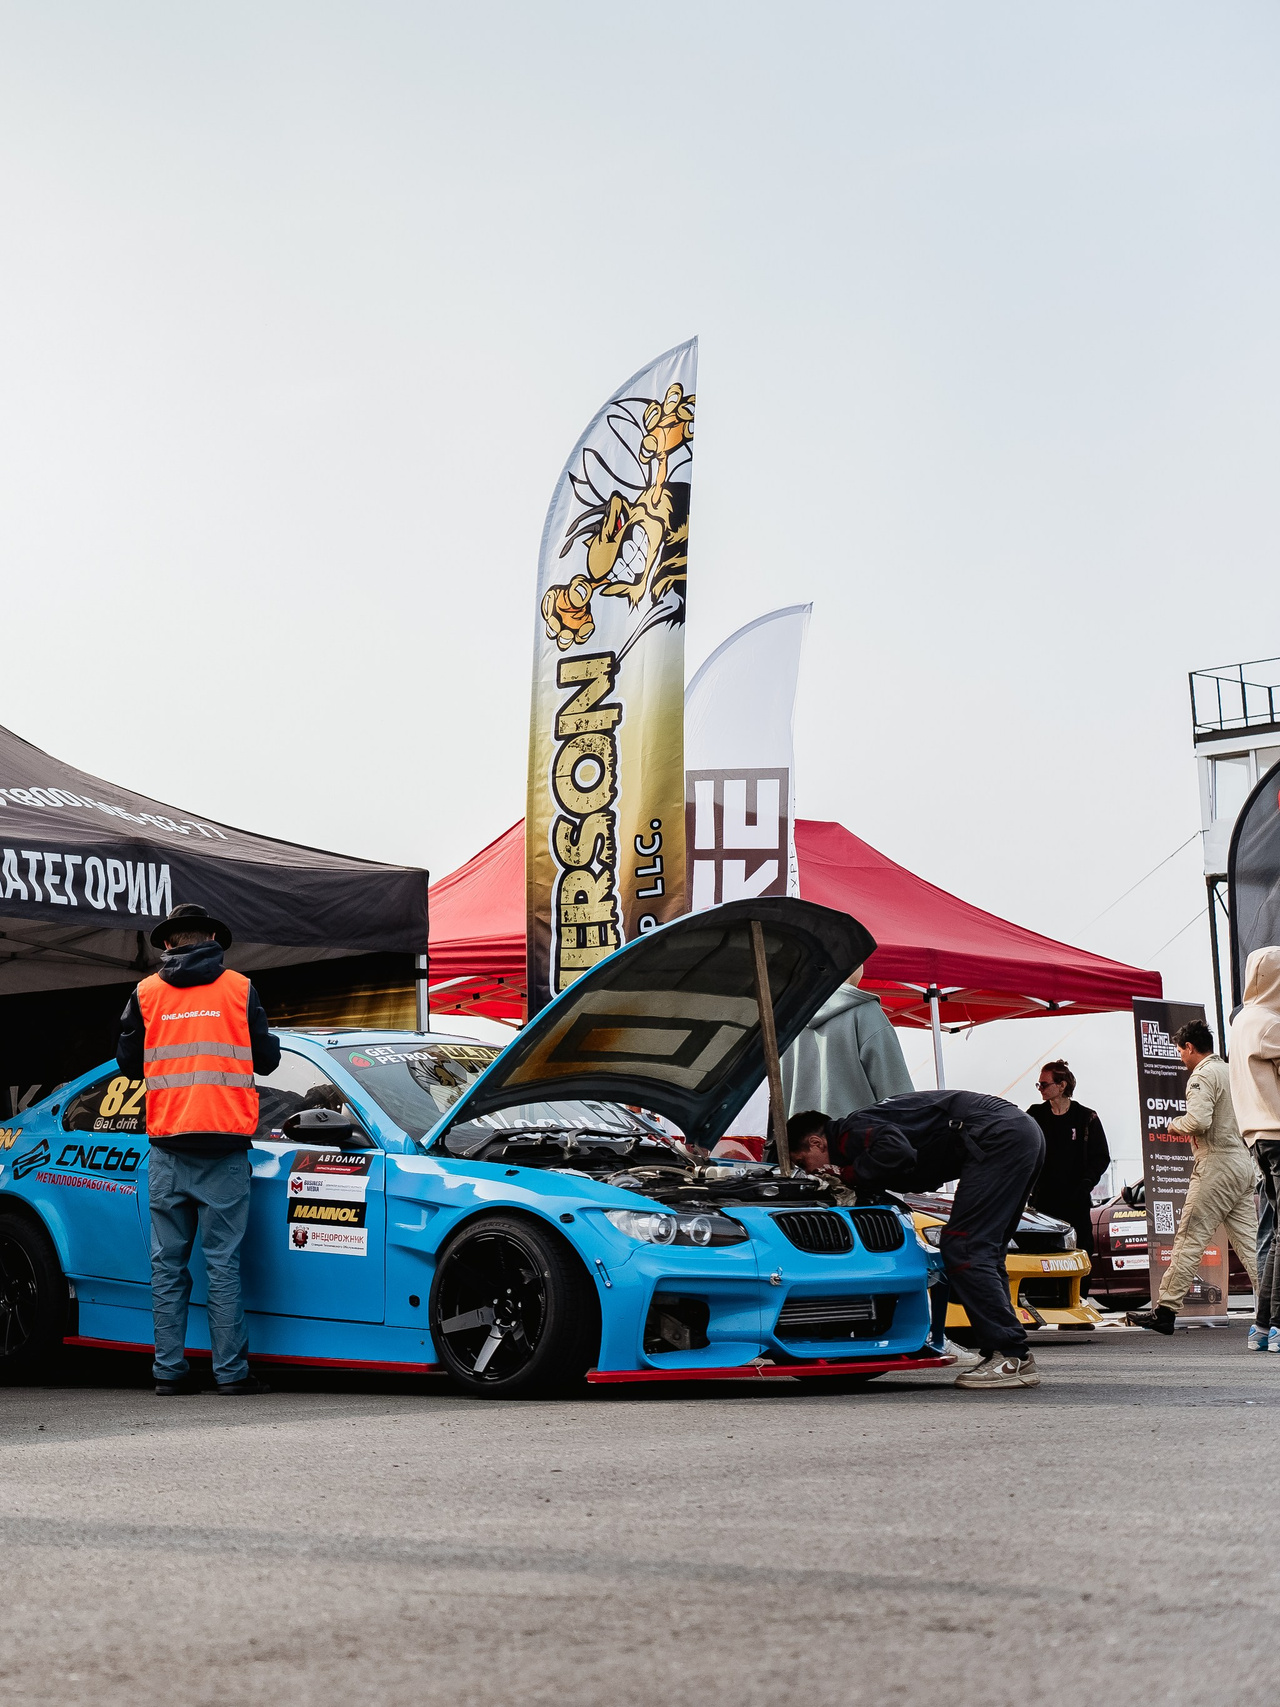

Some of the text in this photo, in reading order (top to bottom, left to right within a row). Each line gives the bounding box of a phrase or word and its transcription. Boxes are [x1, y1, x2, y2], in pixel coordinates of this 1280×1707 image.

[556, 653, 621, 992] ERSON
[635, 818, 665, 899] LLC.
[161, 1010, 221, 1021] ONE.MORE.CARS
[365, 1046, 396, 1057] GET
[376, 1051, 438, 1065] PETROL
[1144, 1045, 1181, 1058] EXPERIEN
[99, 1076, 147, 1117] 82
[1147, 1098, 1187, 1111] ОБУЧЕ
[1148, 1116, 1171, 1130] ДРИ
[1149, 1133, 1191, 1143] В ЧЕЛЯБИ
[55, 1145, 141, 1172] CNC66
[318, 1154, 366, 1164] АВТОЛИГА
[35, 1172, 117, 1192] МЕТАЛЛООБРАБОТКА
[293, 1205, 359, 1222] MANNOL
[1113, 1210, 1146, 1218] MANNO
[311, 1232, 365, 1244] ВНЕДОРОЖНИК
